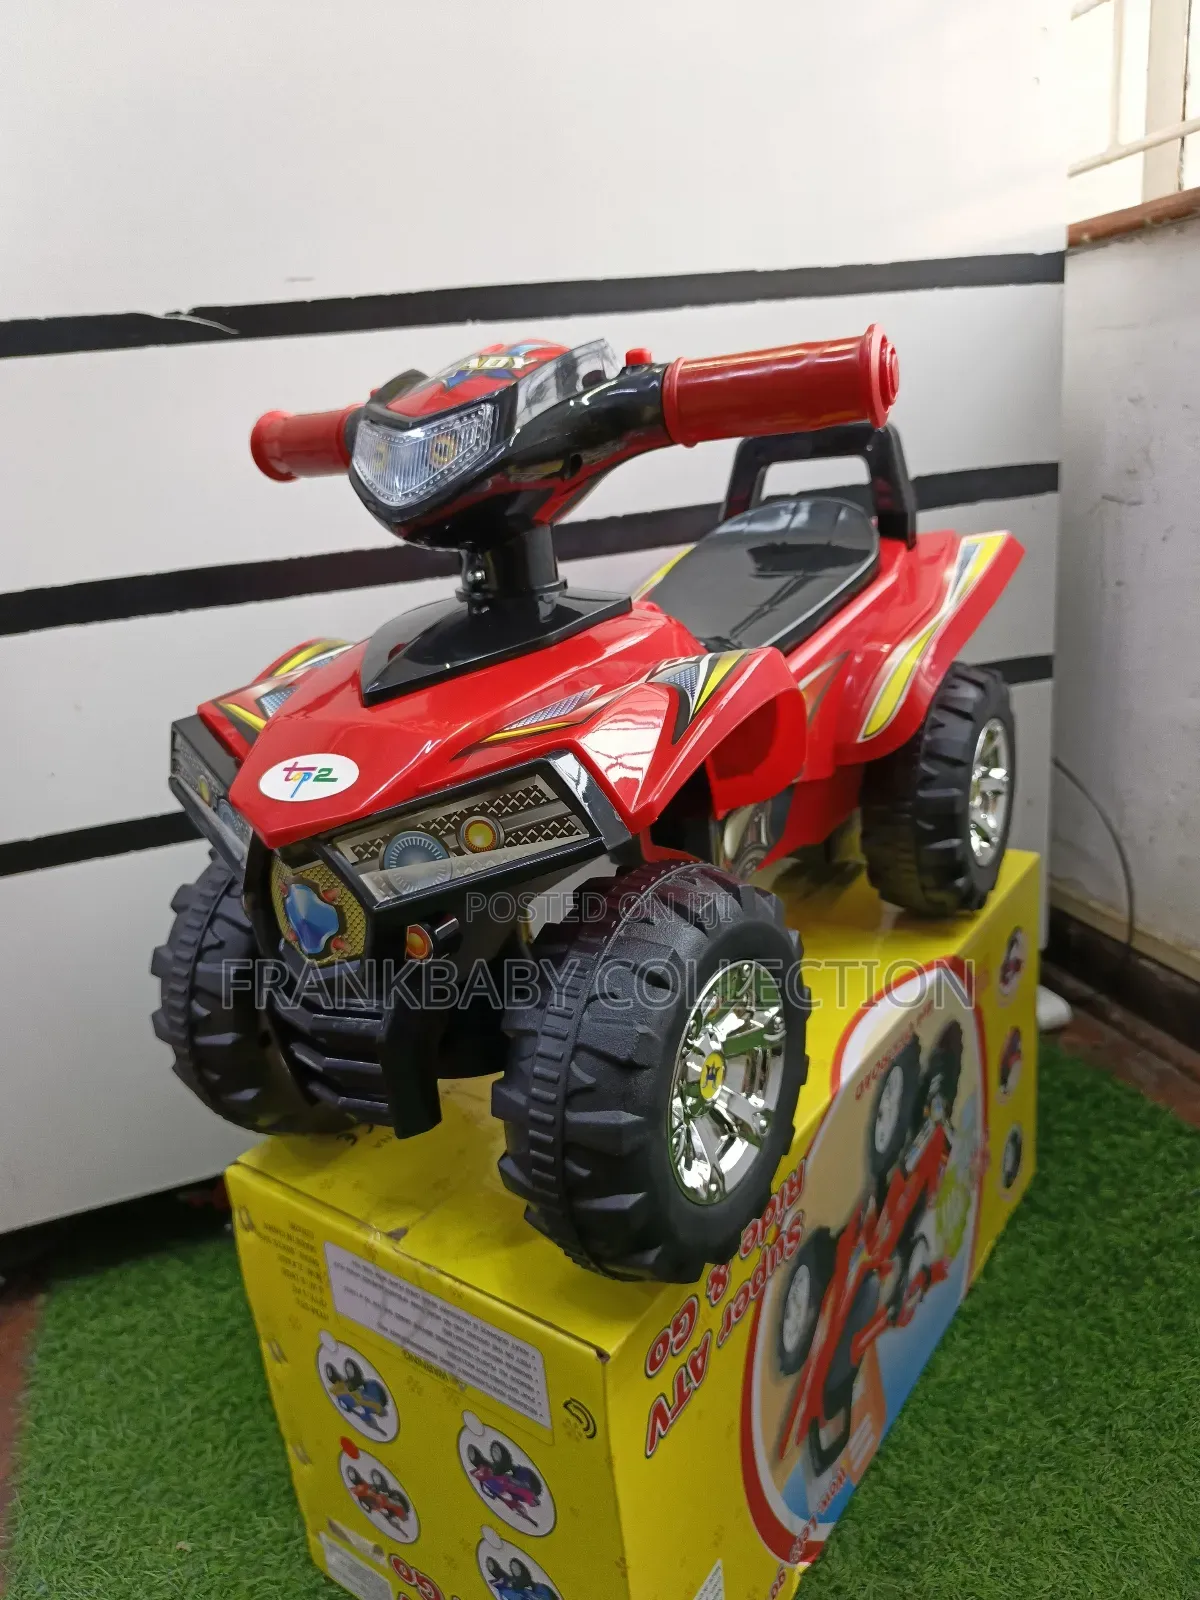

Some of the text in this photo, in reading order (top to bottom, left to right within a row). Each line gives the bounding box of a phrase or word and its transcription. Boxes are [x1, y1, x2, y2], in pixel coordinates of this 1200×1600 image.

[645, 1157, 806, 1378] Ride & Go
[645, 1209, 804, 1459] Super ATV
